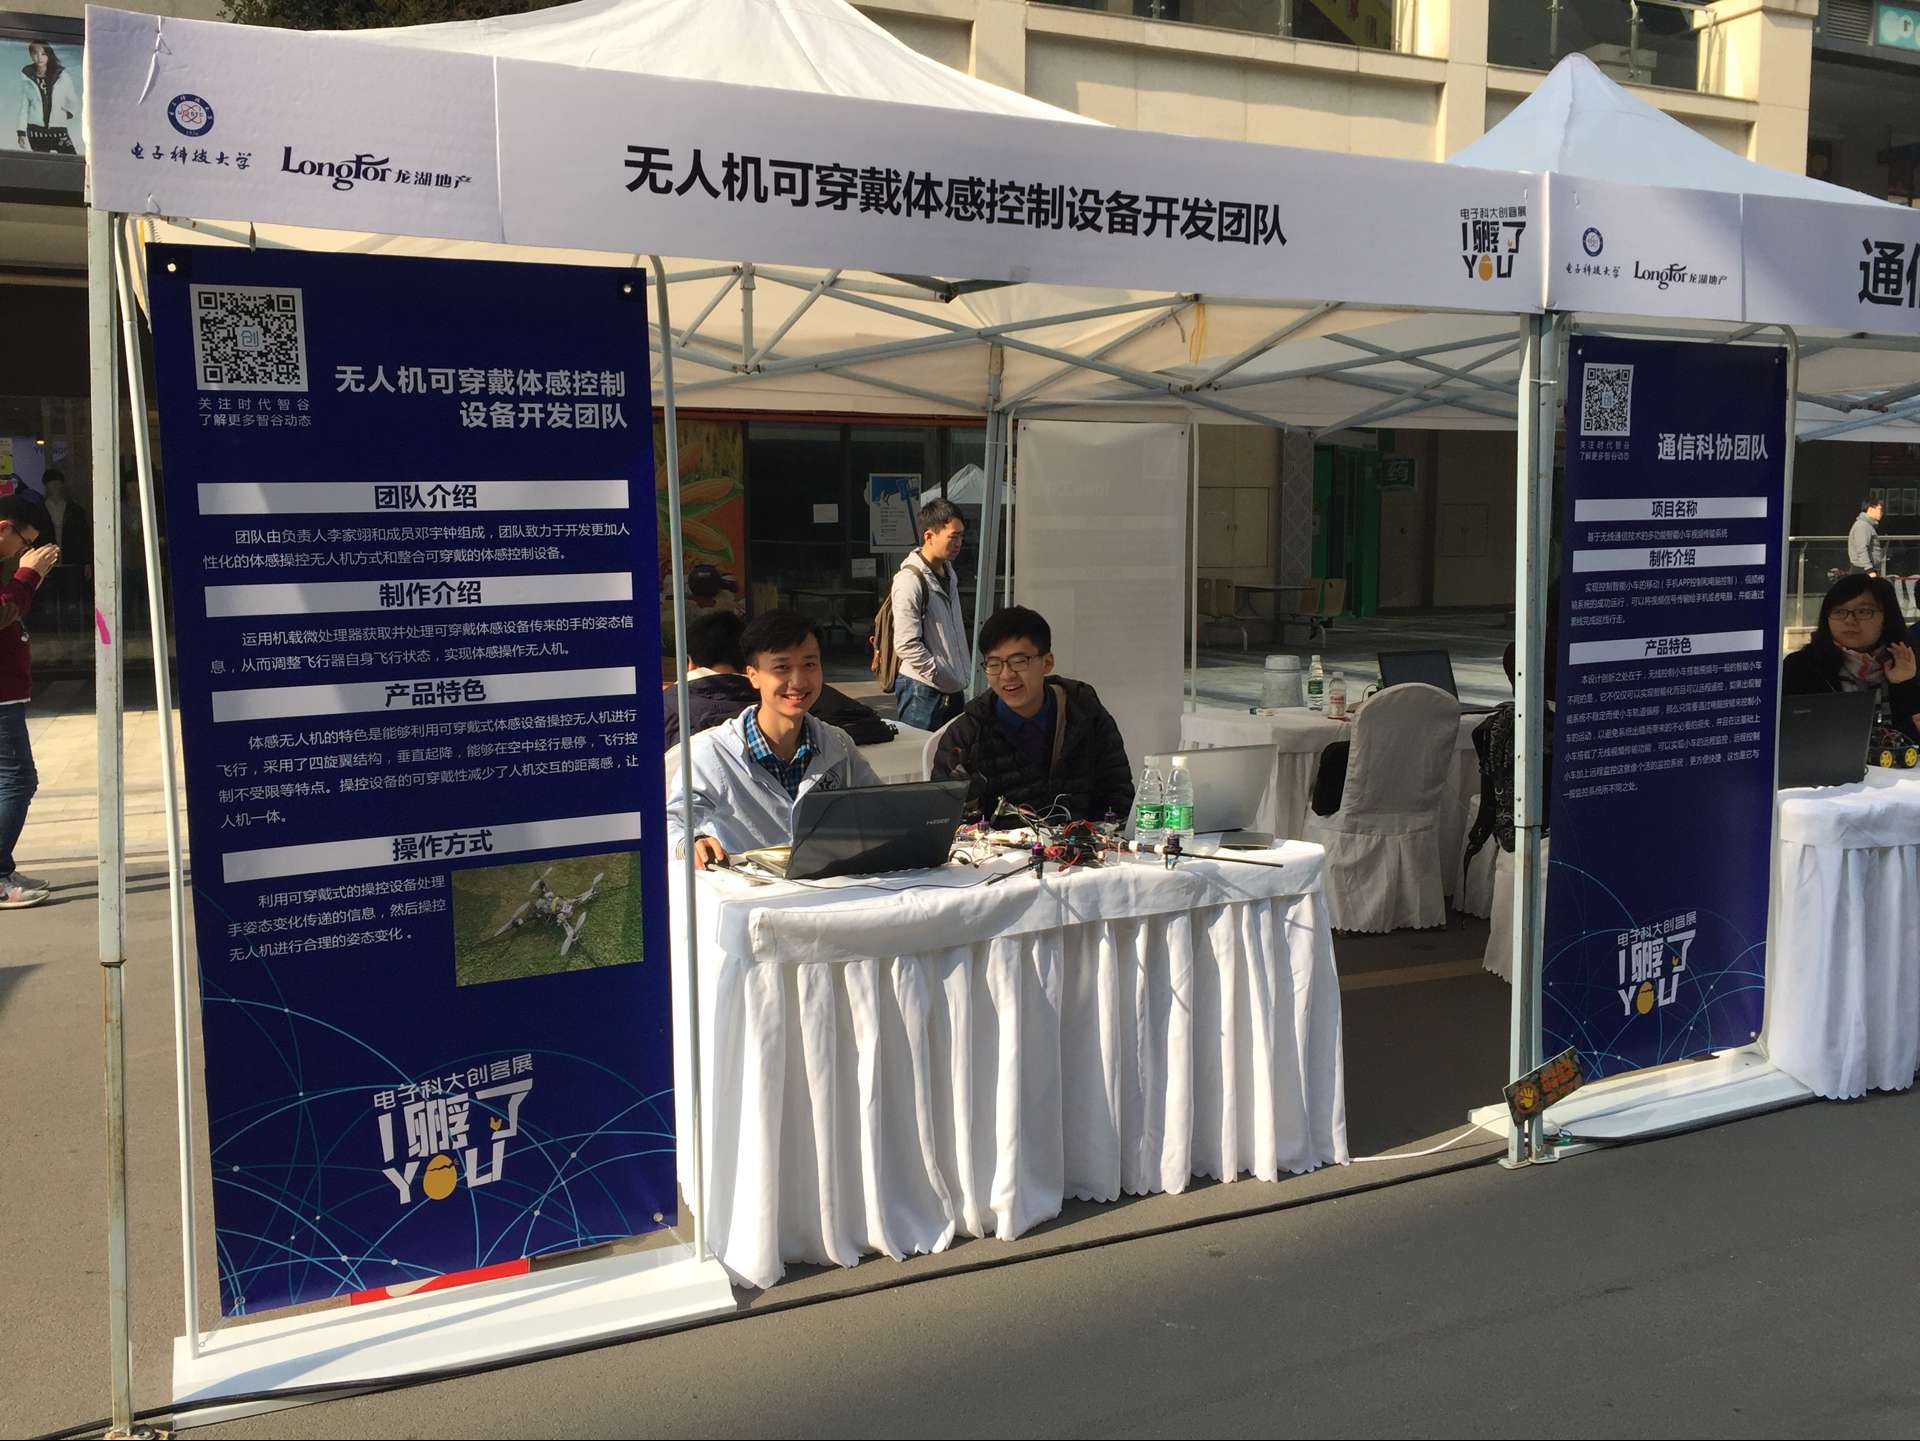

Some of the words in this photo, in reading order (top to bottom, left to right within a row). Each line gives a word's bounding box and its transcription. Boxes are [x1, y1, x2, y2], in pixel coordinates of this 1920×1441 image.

[130, 141, 253, 171] 电子科技大学
[394, 168, 473, 190] 龙湖地产
[624, 143, 1288, 247] 无人机可穿戴体感控制设备开发团队
[1565, 262, 1621, 279] 电子科技大学
[335, 365, 626, 398] 无人机可穿戴体感控制
[198, 397, 310, 411] 关注时代智谷
[459, 401, 628, 430] 设备开发团队
[199, 413, 312, 427] 了解更多智谷动态
[1658, 433, 1769, 461] 通信科协团队
[374, 484, 478, 511] 团队介绍
[1651, 500, 1698, 519] 项目名称
[202, 546, 566, 570] 性化的体感操控无人机方式和整合可穿戴的体感控制设备。
[1649, 548, 1696, 567] 制作介绍
[379, 581, 482, 608] 制作介绍
[210, 641, 570, 675] 息，从而调整飞行器自身飞行状态，实现体感操作无人机。
[1645, 637, 1691, 657] 产品特色
[384, 678, 487, 709] 产品特色
[248, 708, 637, 751] 体感无人机的特色是能够利用可穿戴式体感设备操控无人机进行
[220, 808, 288, 829] 人机一体。
[392, 829, 494, 862] 操作方式
[258, 873, 446, 909] 利用可穿戴式的操控设备处理
[228, 898, 447, 937] 手姿态变化传递的信息，然后操控
[373, 1053, 534, 1110] 电子科大创客展
